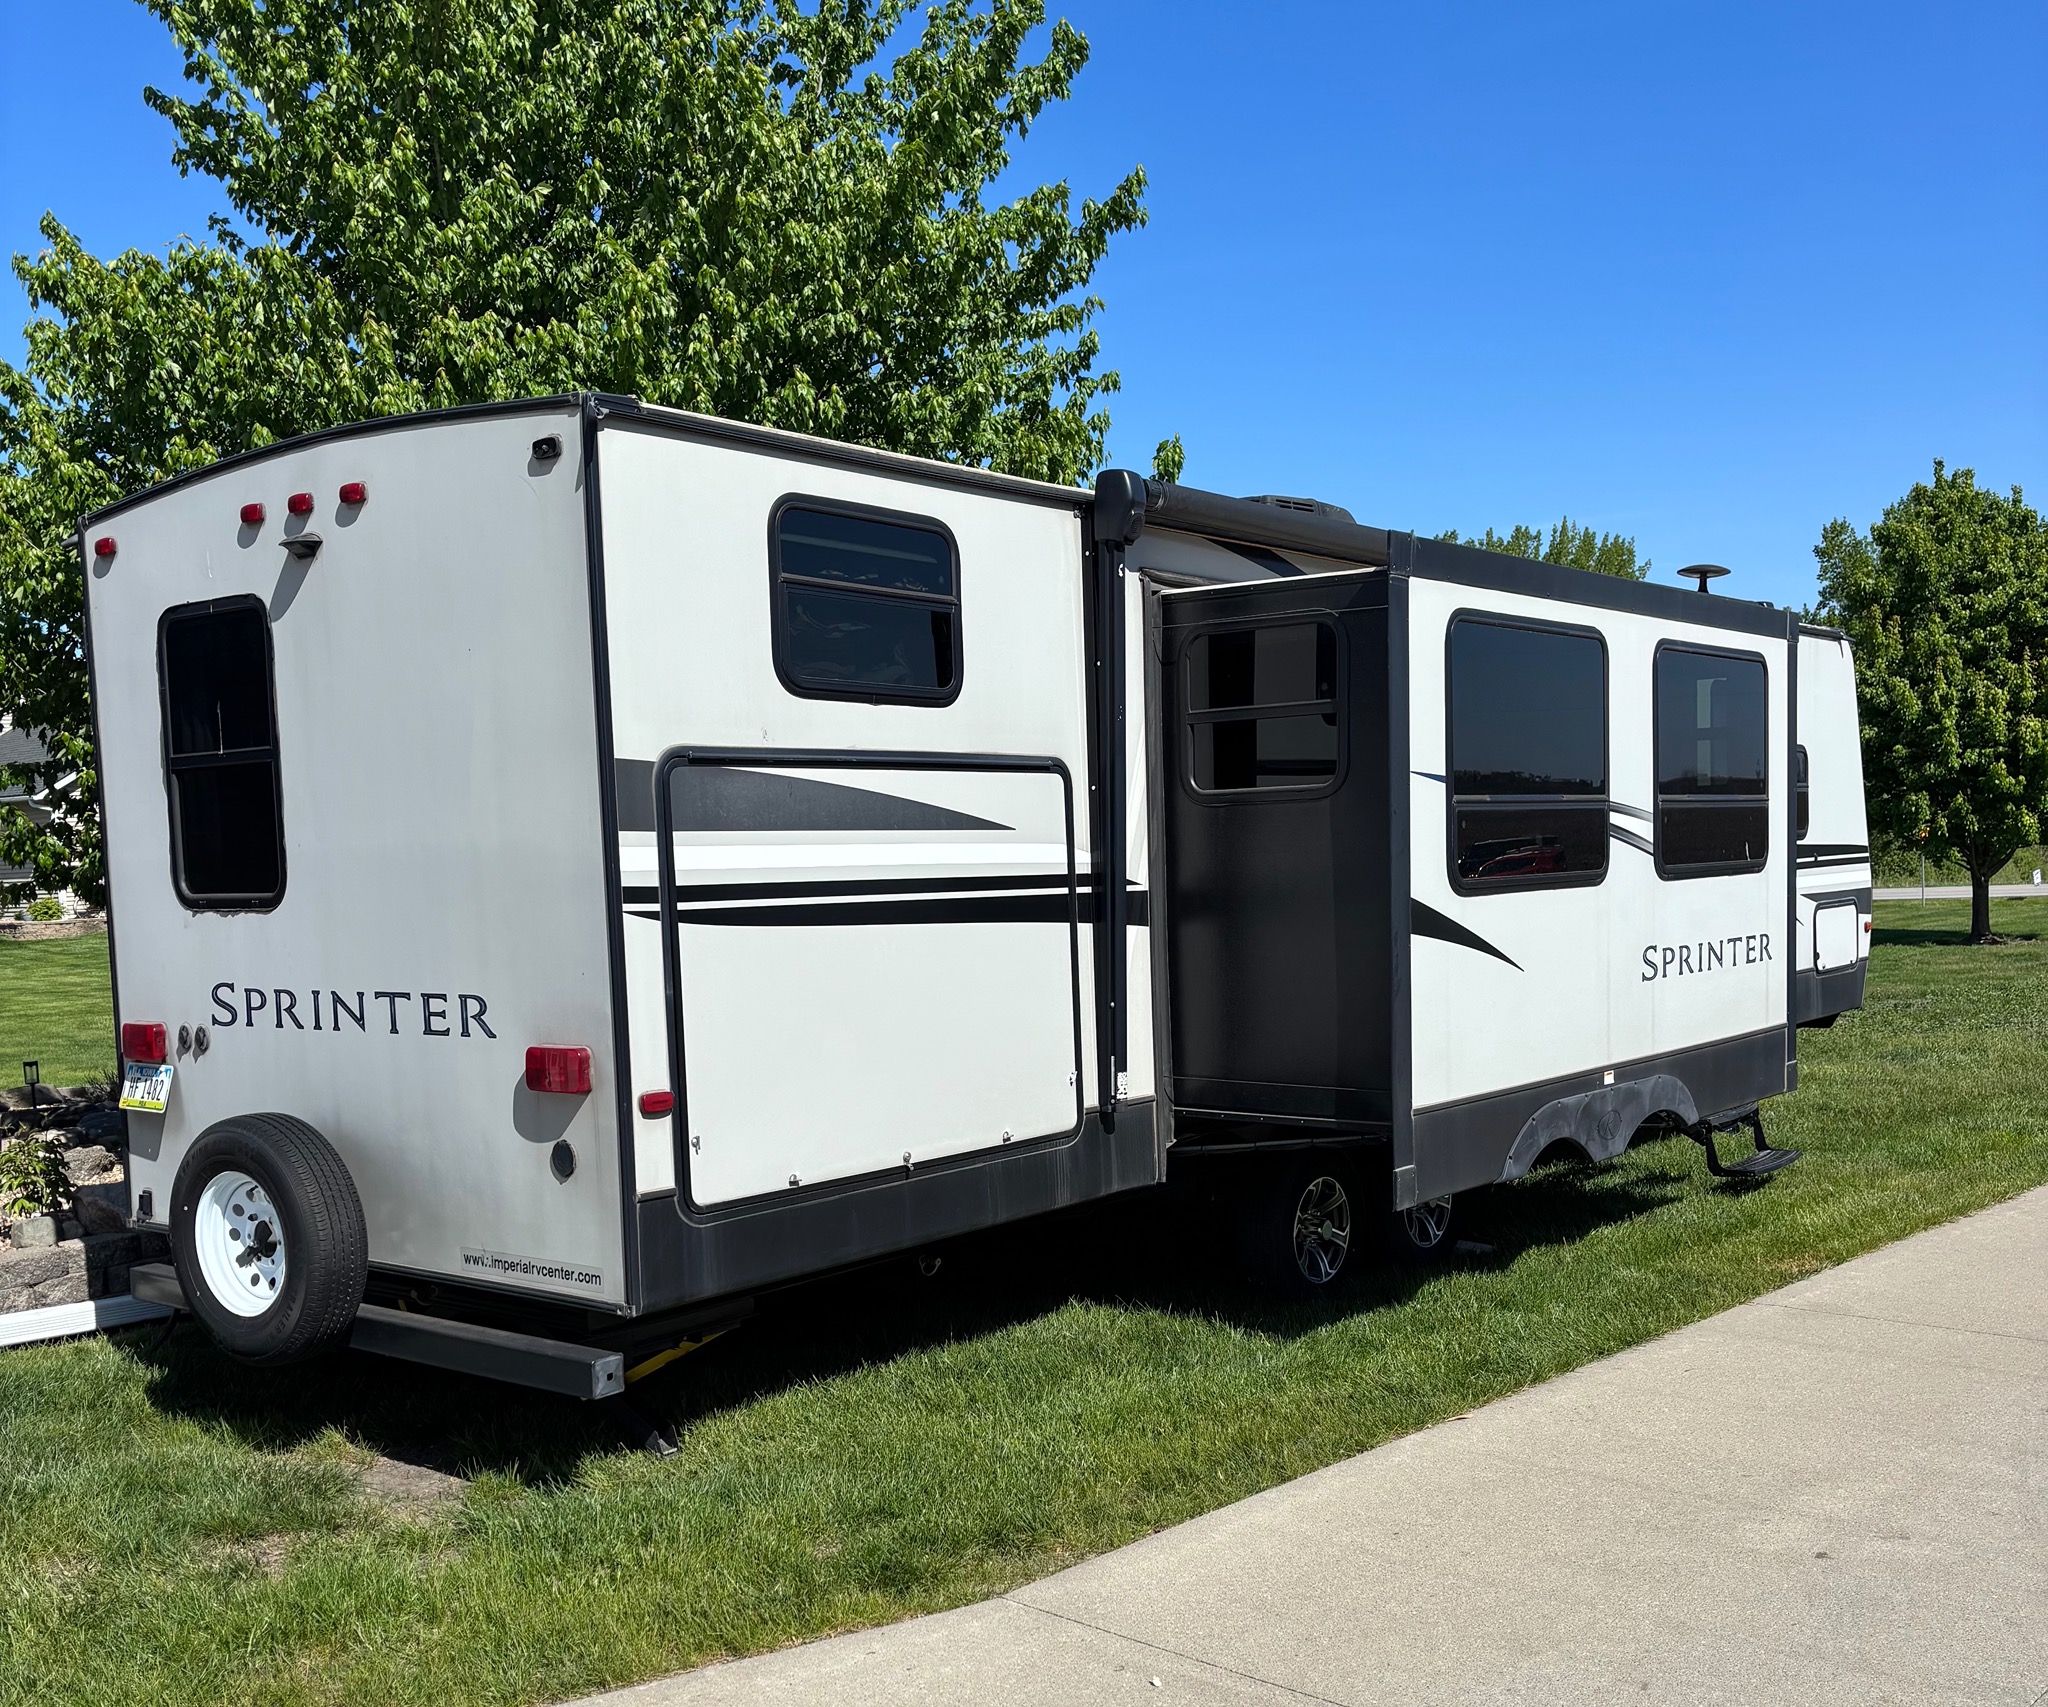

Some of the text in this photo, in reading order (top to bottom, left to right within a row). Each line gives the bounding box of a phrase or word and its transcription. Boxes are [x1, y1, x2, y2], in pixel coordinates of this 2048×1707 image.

[1641, 933, 1773, 983] SPRINTER
[211, 981, 498, 1039] SPRINTER
[128, 1076, 165, 1101] HF 1482
